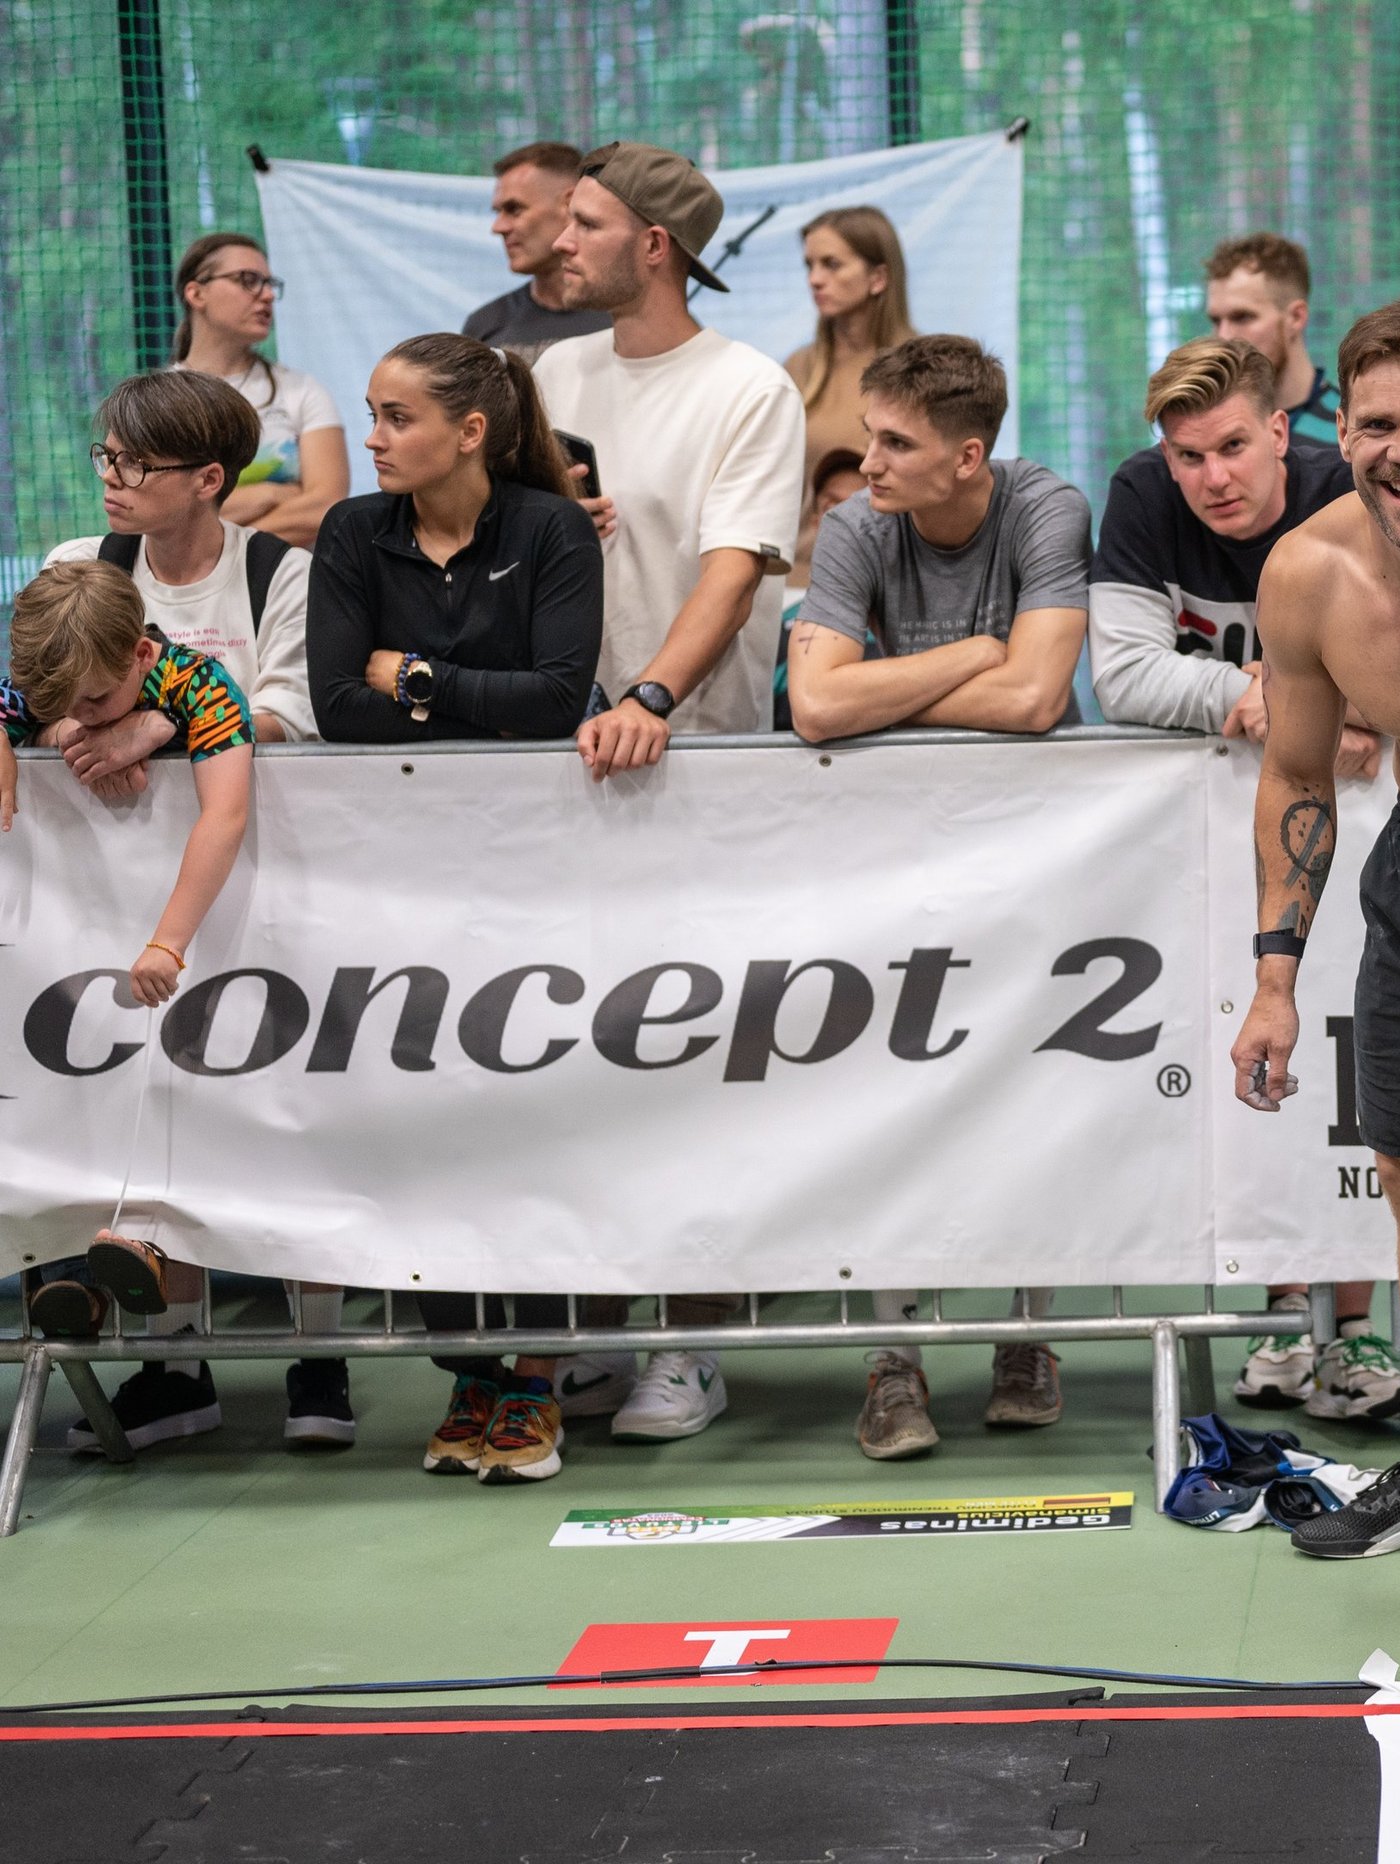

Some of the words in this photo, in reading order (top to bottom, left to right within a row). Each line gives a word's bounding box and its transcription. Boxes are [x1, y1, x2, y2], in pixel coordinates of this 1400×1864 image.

[23, 946, 972, 1083] concept
[1033, 936, 1164, 1062] 2
[957, 1507, 1111, 1519] Simanavicius
[880, 1514, 1111, 1531] Gediminas
